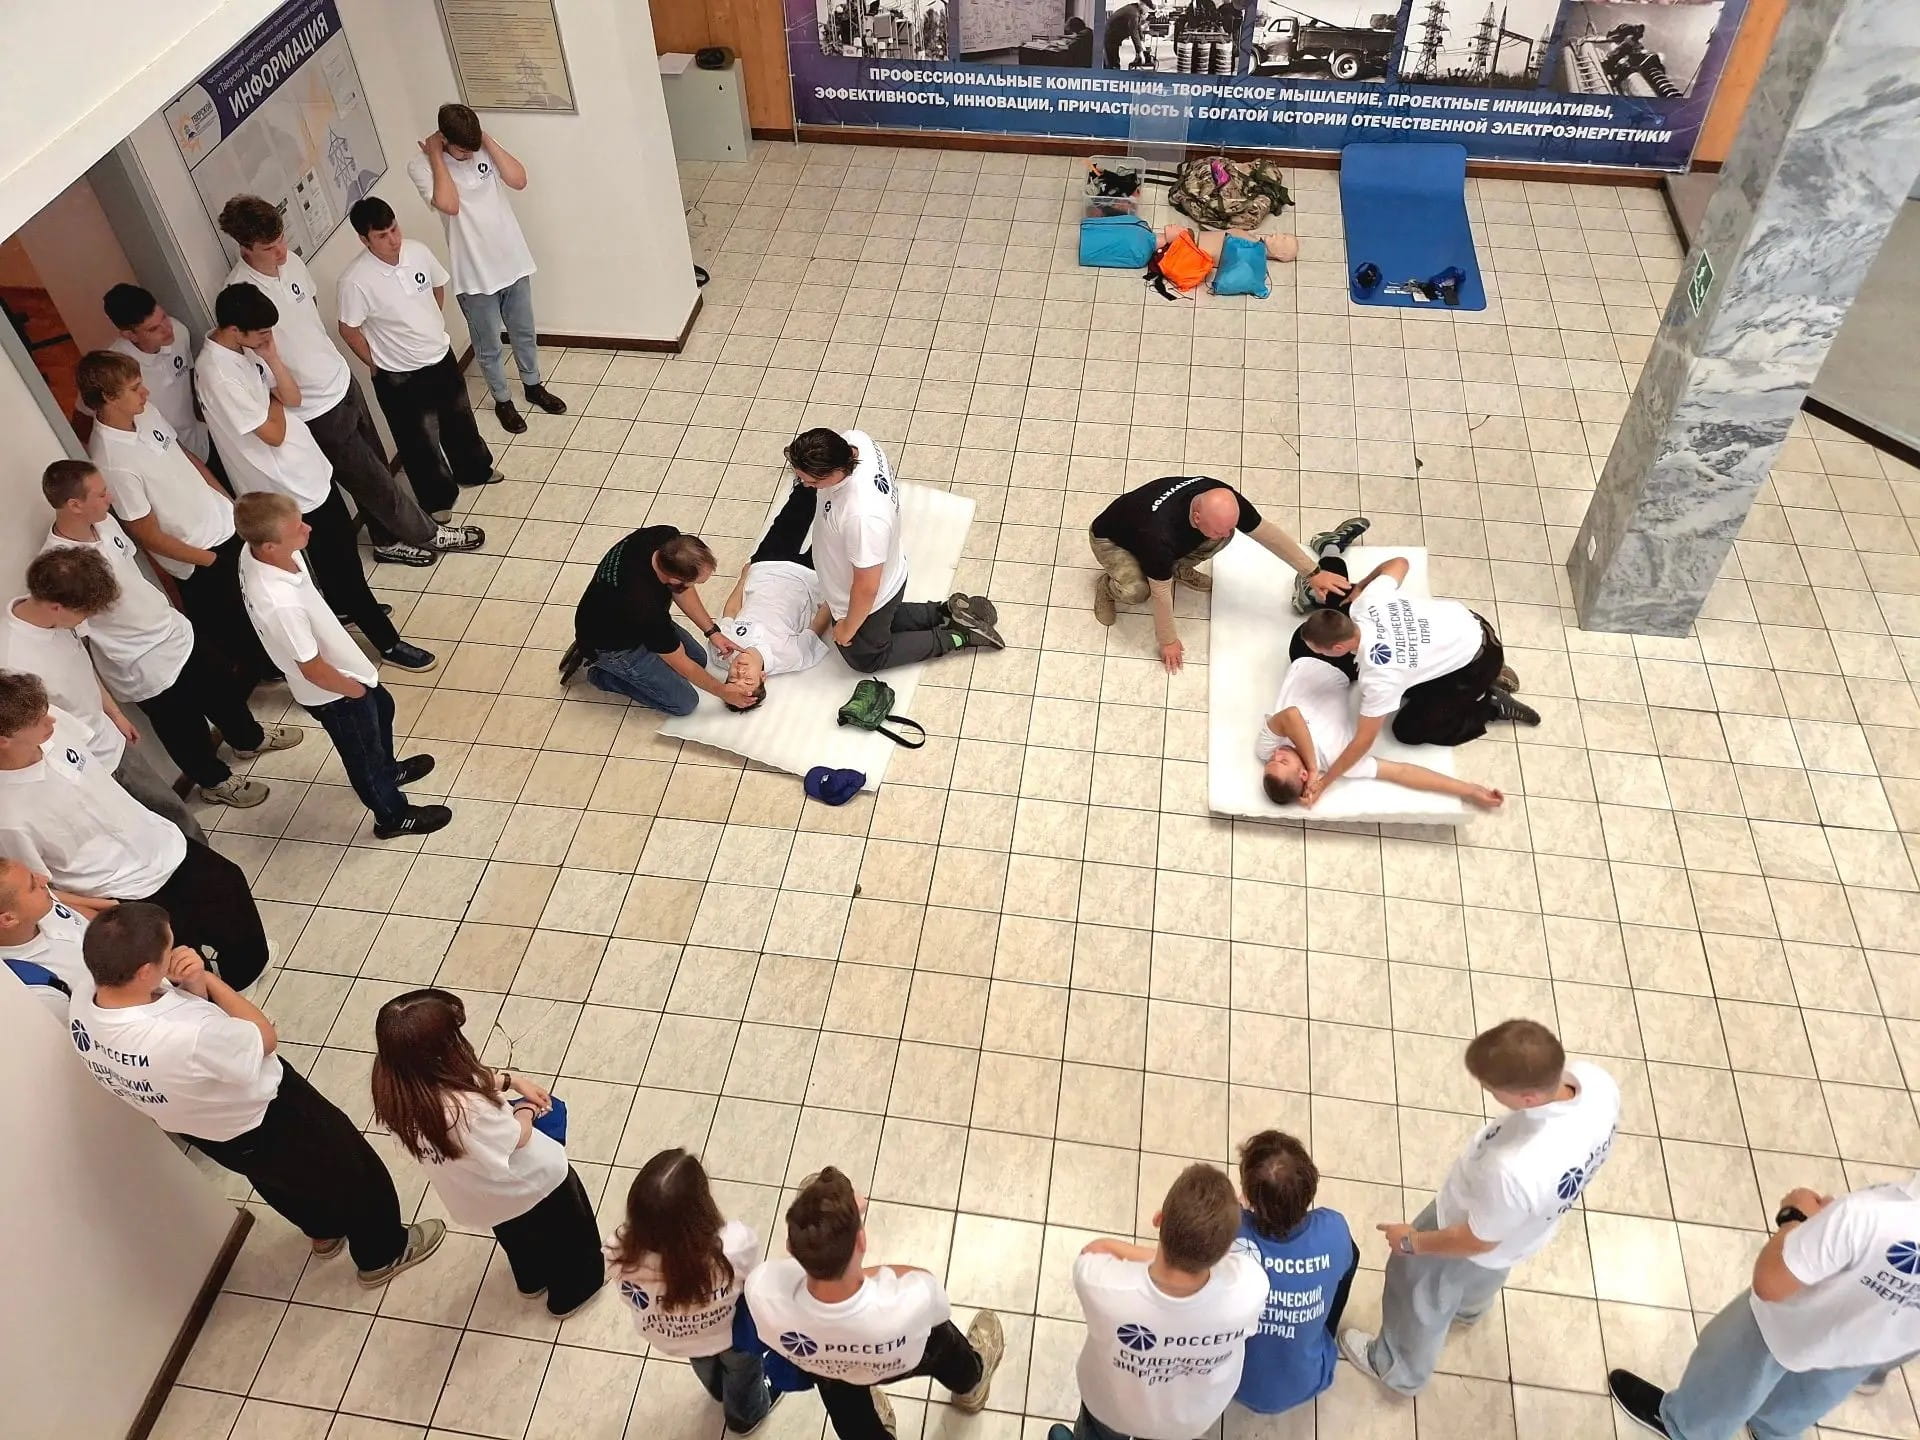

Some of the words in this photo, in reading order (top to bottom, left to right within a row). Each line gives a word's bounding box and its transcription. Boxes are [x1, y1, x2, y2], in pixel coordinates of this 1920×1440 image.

[228, 11, 329, 119] ИНФОРМАЦИЯ
[869, 67, 1042, 89] ПРОФЕССИОНАЛЬНЫЕ
[1046, 76, 1169, 96] КОМПЕТЕНЦИИ,
[1171, 83, 1275, 100] ТВОРЧЕСКОЕ
[1279, 87, 1383, 107] МЫШЛЕНИЕ,
[1387, 94, 1489, 112] ПРОЕКТНЫЕ
[1492, 100, 1615, 121] ИНИЦИАТИВЫ,
[814, 86, 950, 107] ЭФФЕКТИВНОСТЬ,
[953, 93, 1054, 113] ИННОВАЦИИ,
[1057, 99, 1179, 117] ПРИЧАСТНОСТЬ
[1183, 106, 1194, 118] К
[1198, 106, 1269, 122] БОГАТОЙ
[1272, 110, 1348, 127] ИСТОРИИ
[1351, 114, 1489, 134] ОТЕЧЕСТВЕННОЙ
[1490, 122, 1672, 144] ЭЛЕКТРОЭНЕРГЕТИКИ
[1387, 602, 1406, 664] СТУДЕНЧЕСКИЙ
[1399, 598, 1418, 669] ЭНЕРГЕТИЧЕСКИЙ
[1418, 618, 1431, 644] ОТРЯД
[1264, 1254, 1330, 1274] РОССЕТИ
[1267, 1284, 1323, 1308] НЧЕСКИЙ
[1259, 1301, 1325, 1324] ЕТИЧЕСКИЙ
[825, 1335, 907, 1355] РОССЕТИ
[1163, 1328, 1245, 1347] РОССЕТИ
